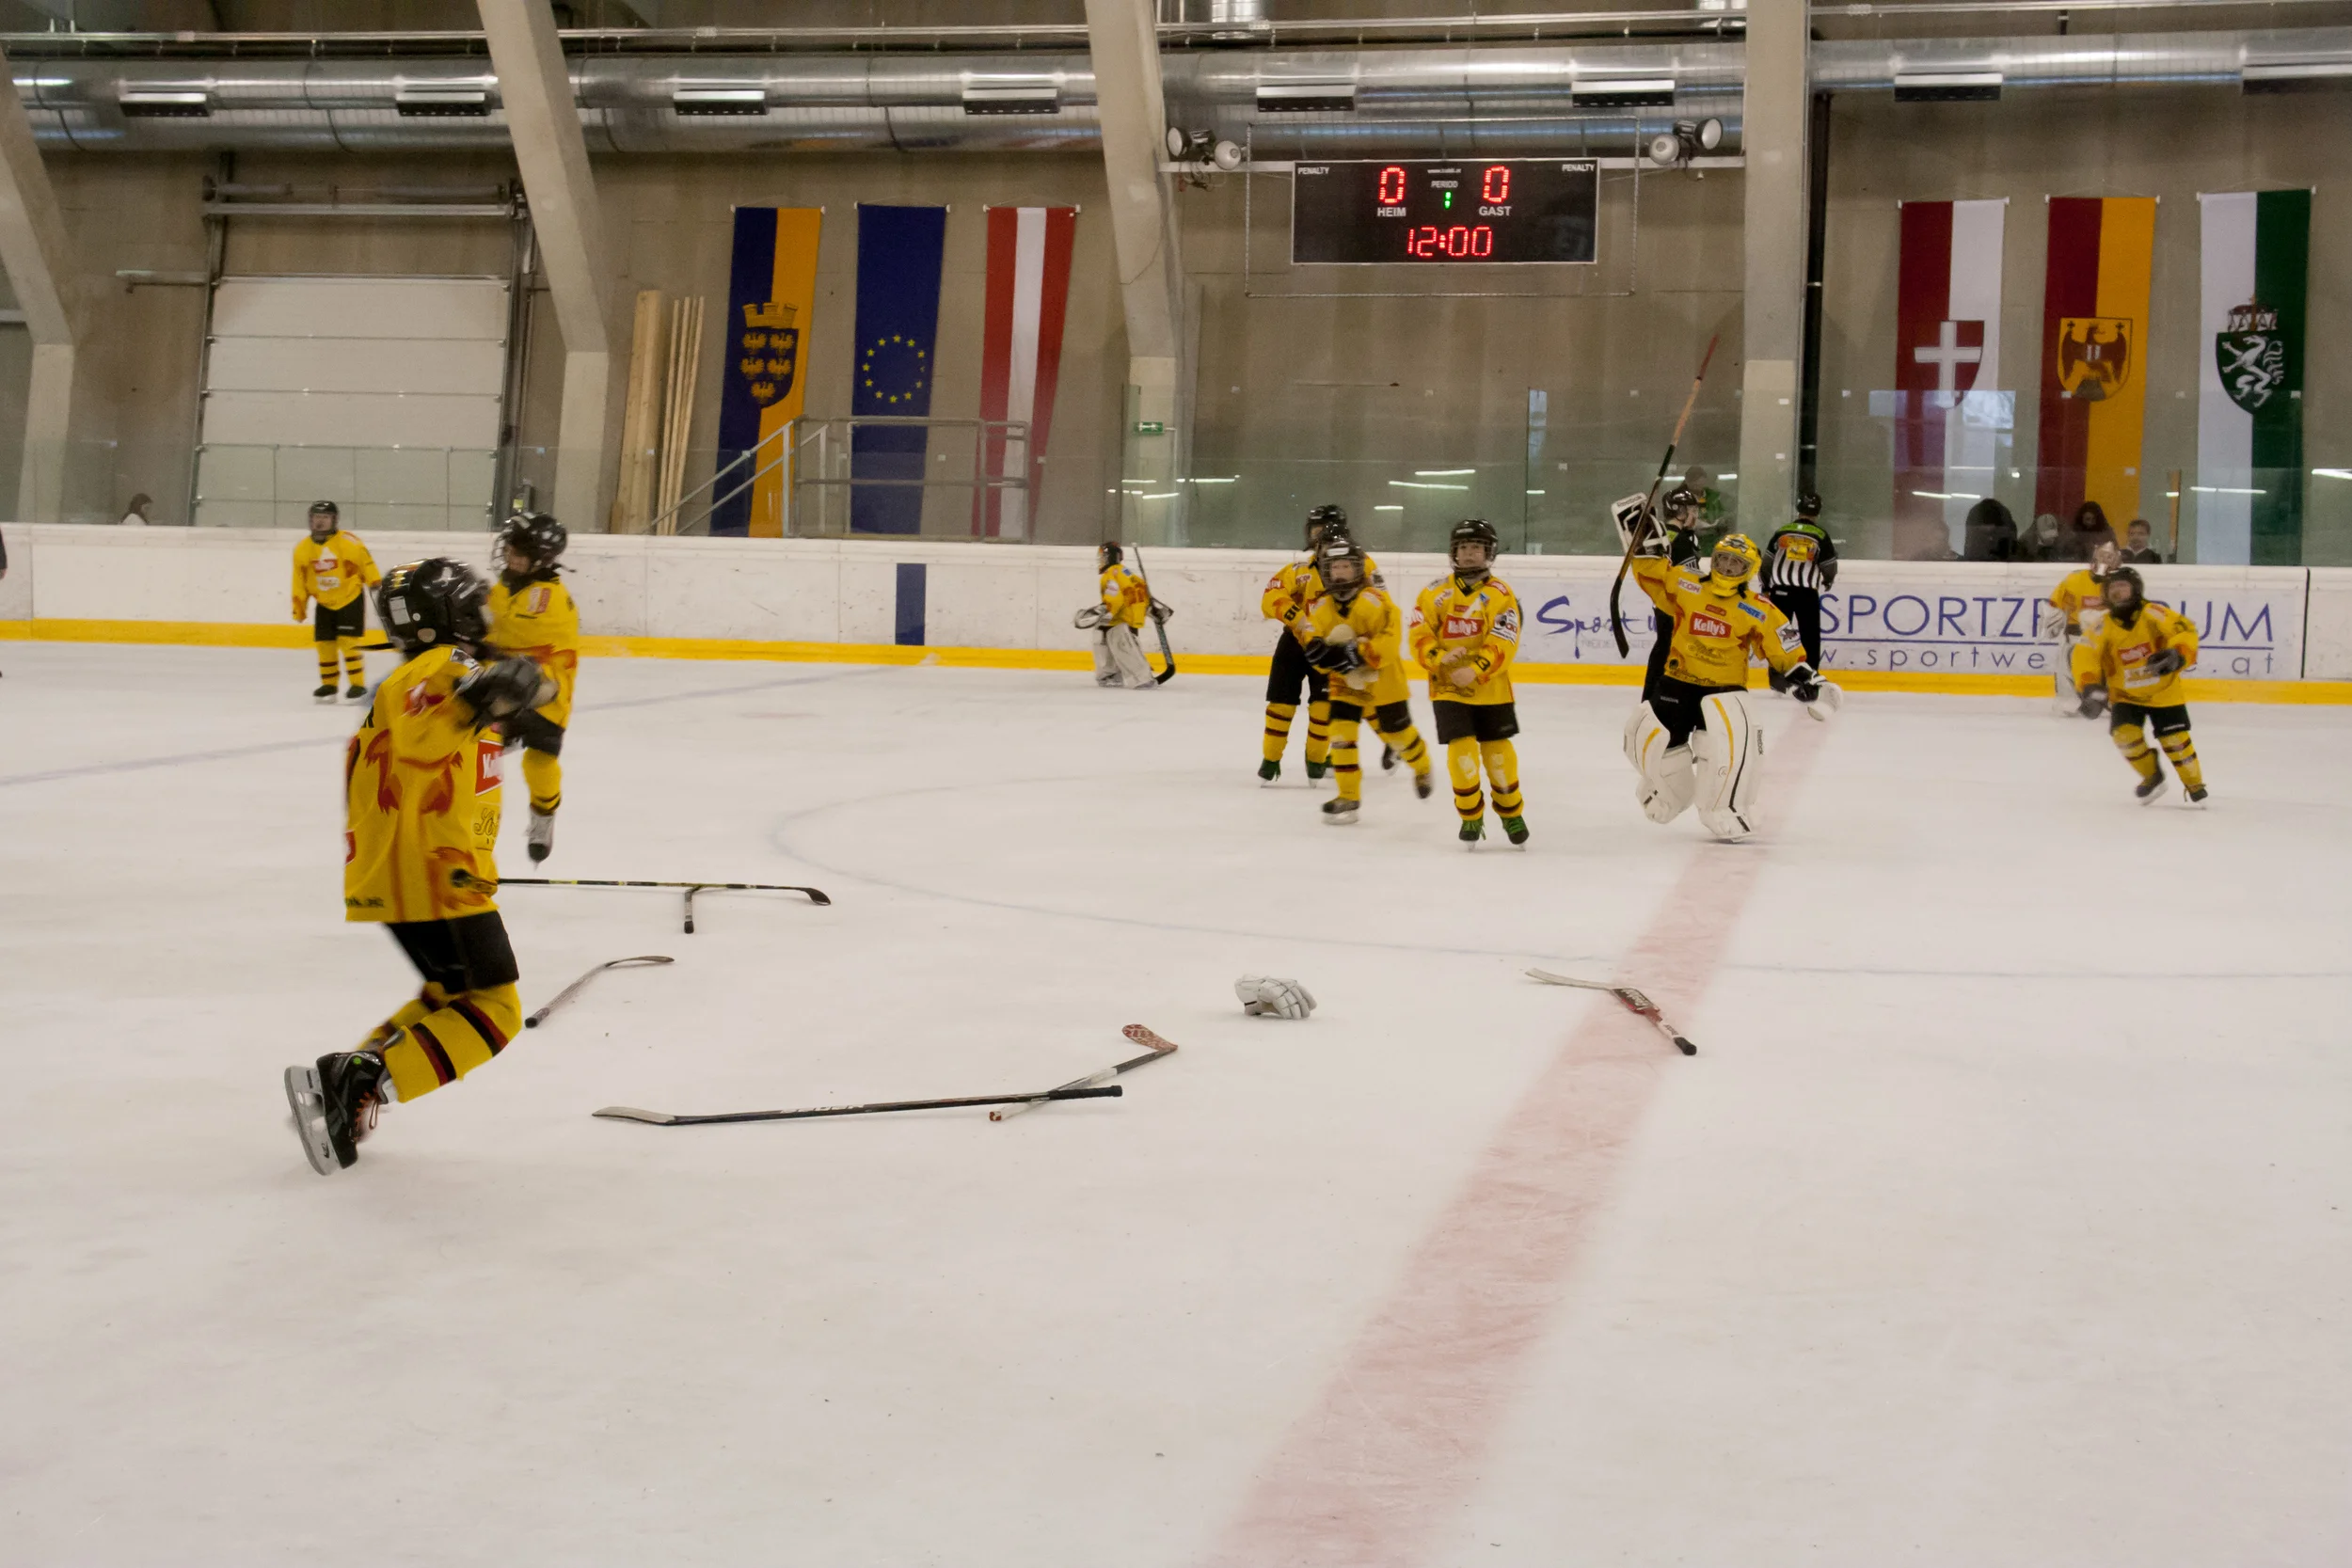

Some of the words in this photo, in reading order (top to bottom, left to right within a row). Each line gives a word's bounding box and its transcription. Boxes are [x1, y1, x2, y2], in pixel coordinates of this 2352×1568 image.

[1298, 166, 1329, 175] PENALTY
[1562, 164, 1595, 172] PENALTY
[1379, 166, 1406, 204] 0
[1483, 165, 1510, 203] 0
[1444, 191, 1452, 209] 1
[1377, 207, 1406, 217] HEIM
[1478, 206, 1513, 216] GAST
[1407, 226, 1492, 257] 12:00
[1693, 617, 1725, 636] Kelly's
